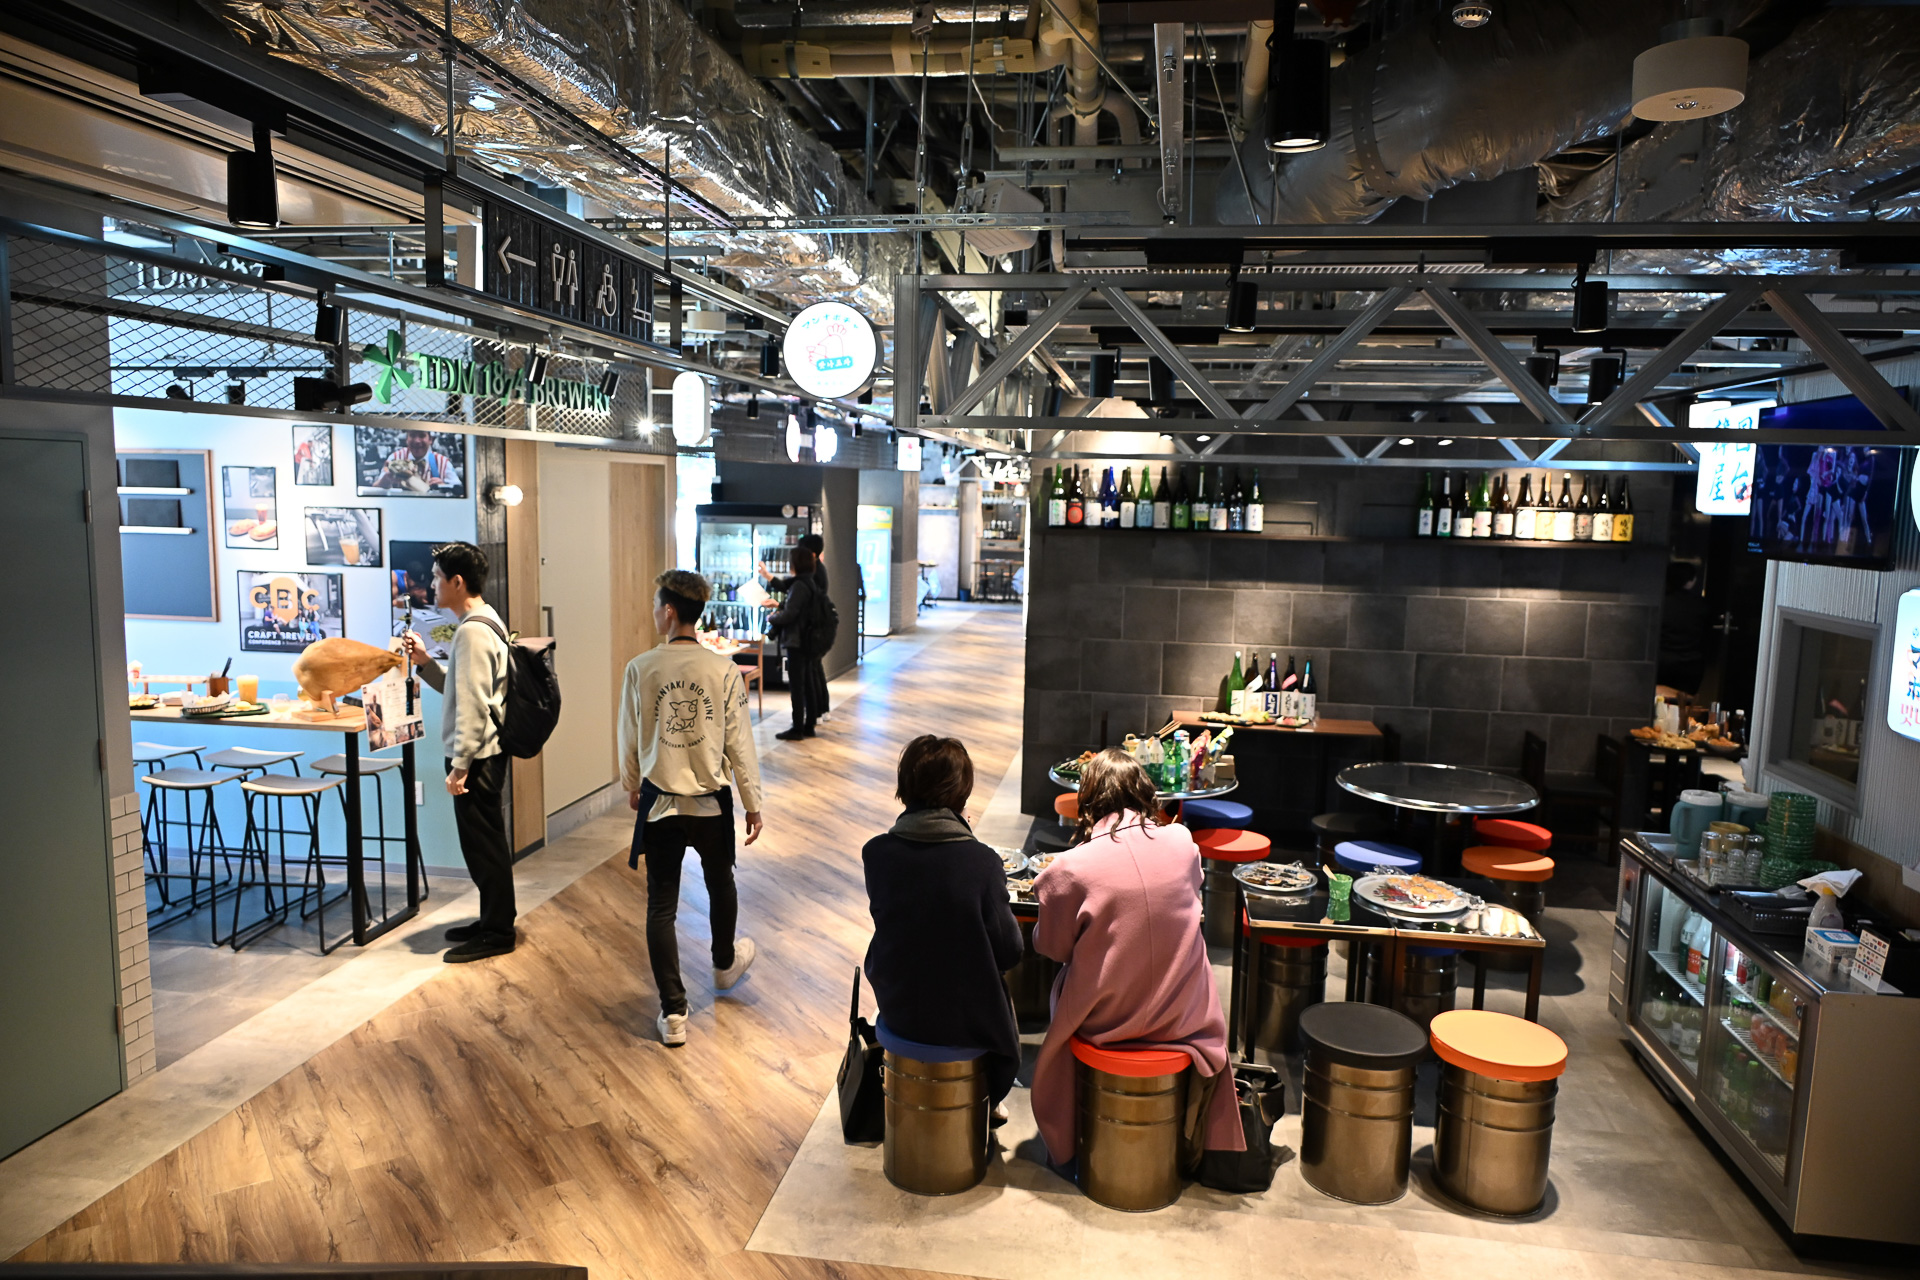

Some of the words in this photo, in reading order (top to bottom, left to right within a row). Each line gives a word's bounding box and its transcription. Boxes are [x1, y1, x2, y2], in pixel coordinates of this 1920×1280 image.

[413, 352, 477, 396] TDM
[479, 360, 527, 406] 1874
[247, 630, 278, 640] CRAFT
[689, 682, 714, 721] BIO-WINE
